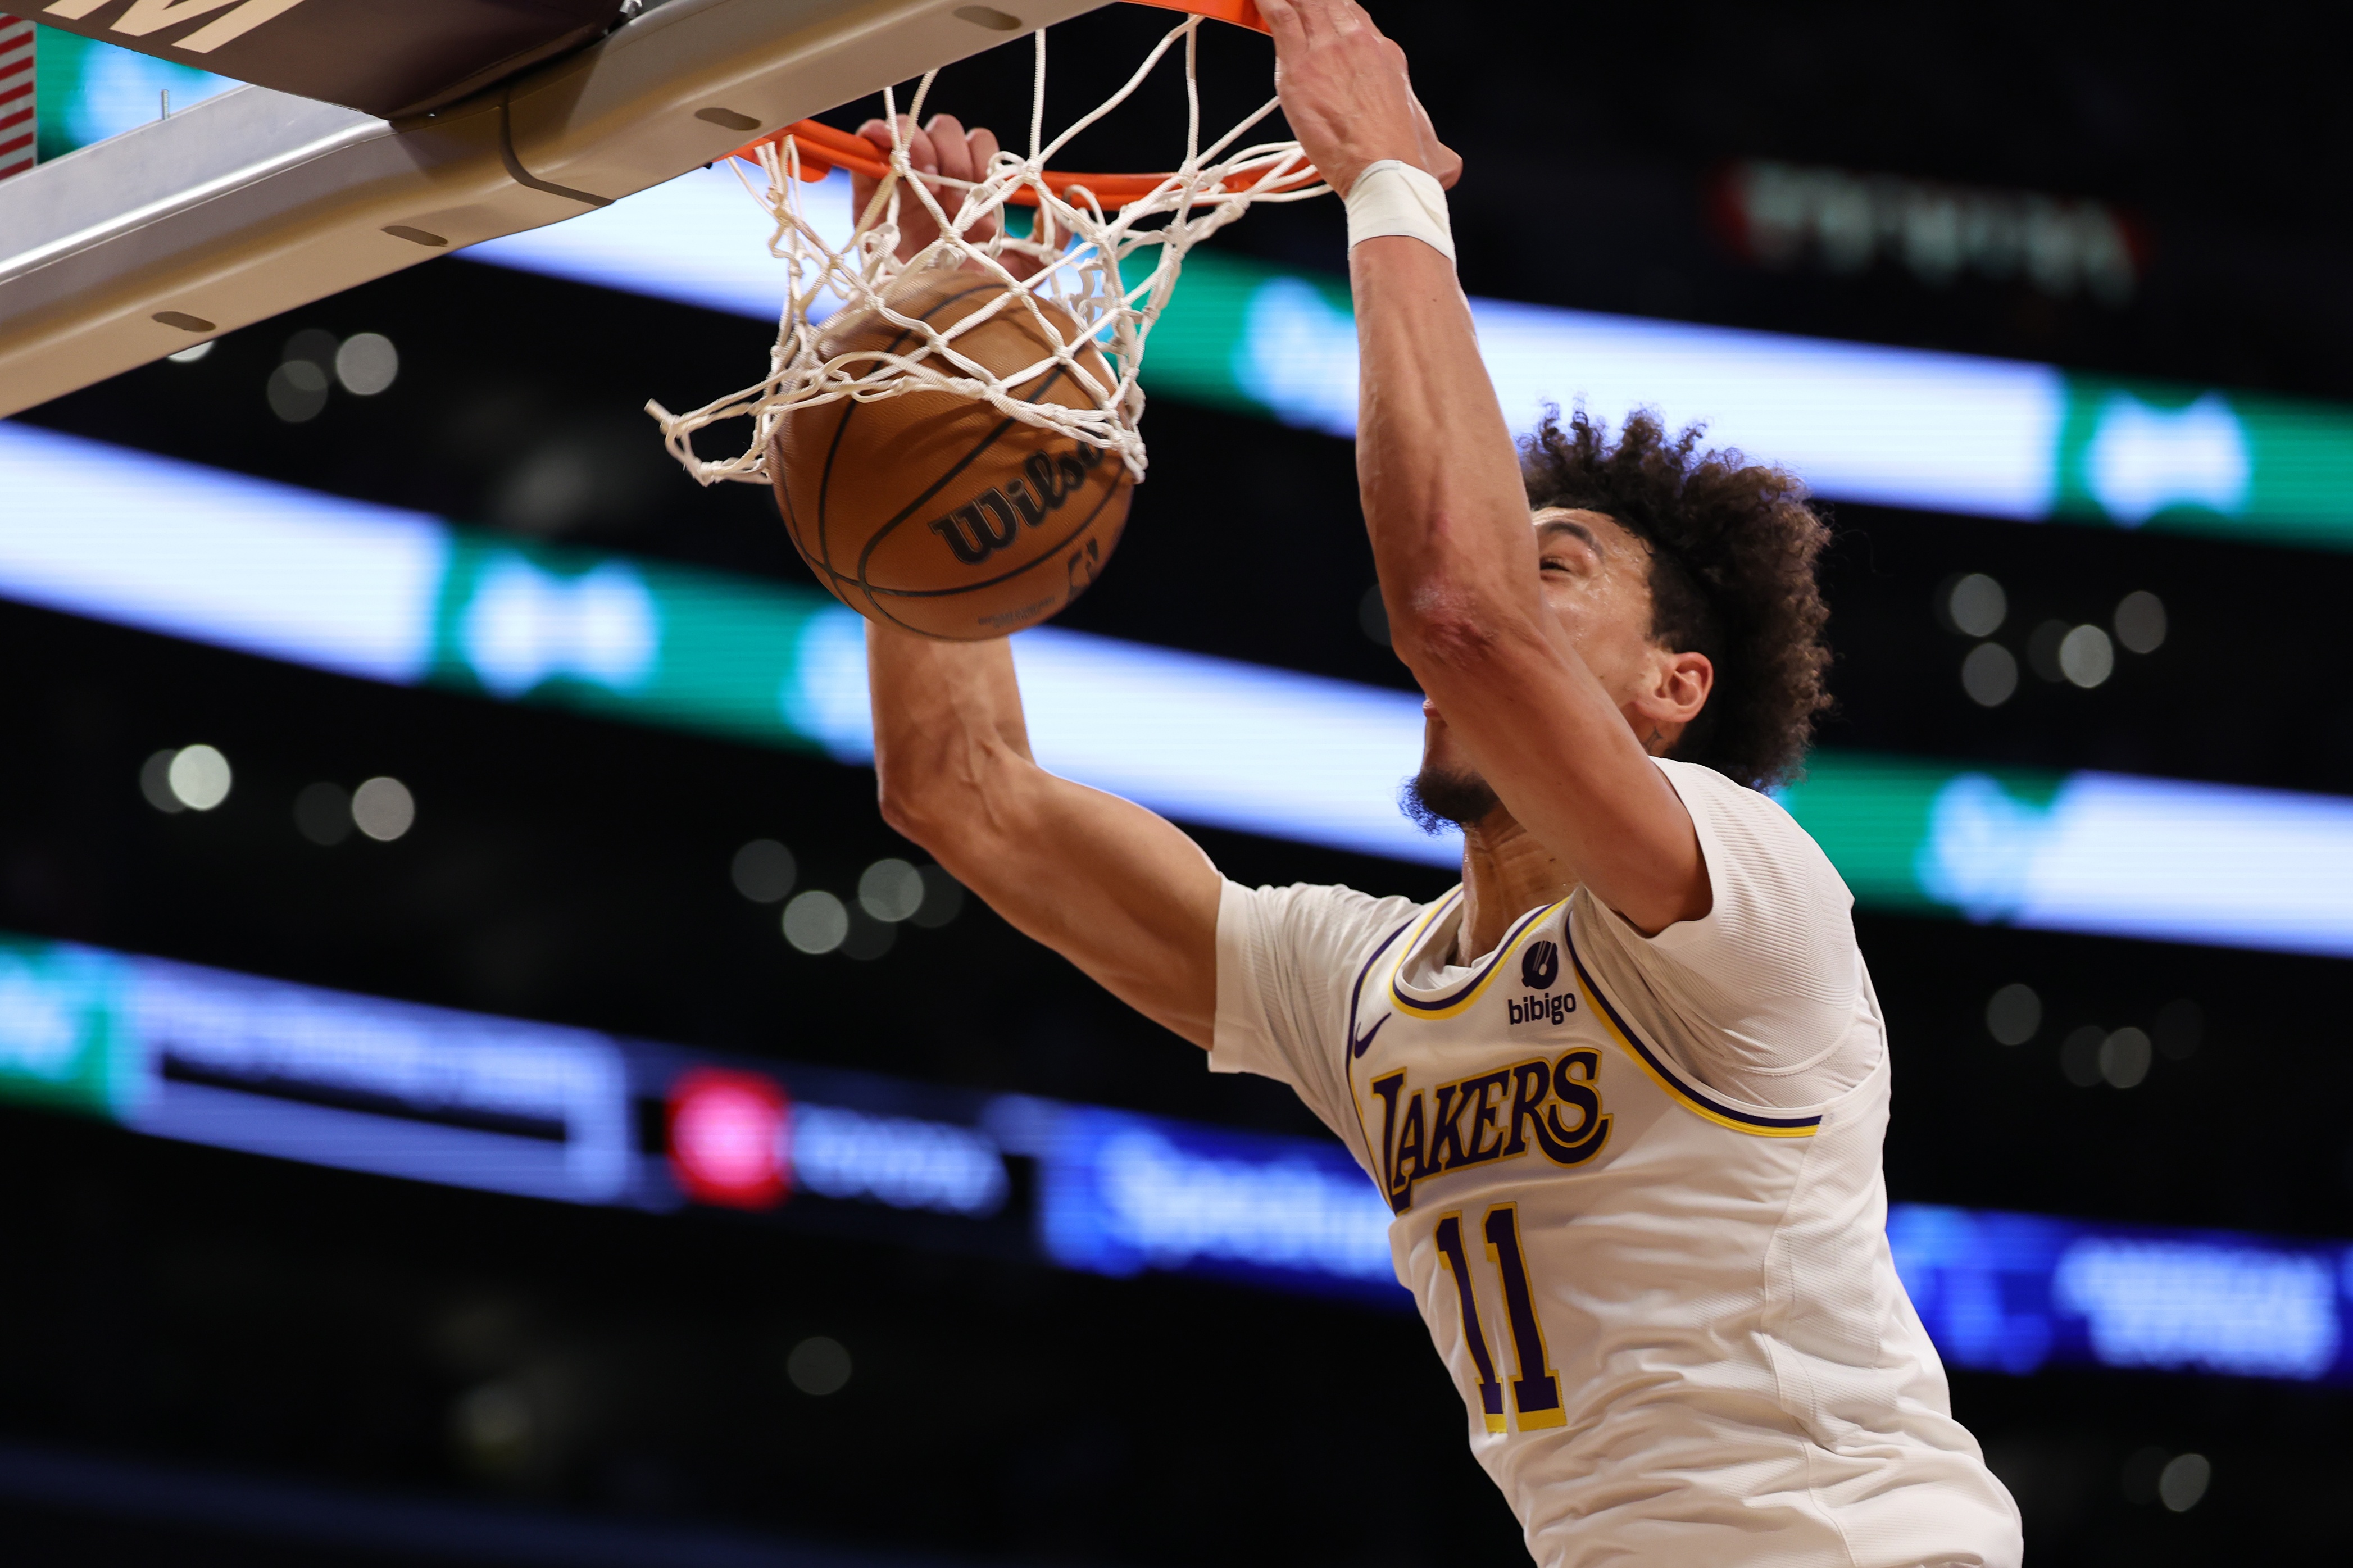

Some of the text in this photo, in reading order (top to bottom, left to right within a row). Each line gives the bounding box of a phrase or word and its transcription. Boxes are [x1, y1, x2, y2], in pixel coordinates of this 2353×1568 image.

[928, 440, 1105, 565] Wilso
[1508, 993, 1577, 1025] bibigo
[1370, 1047, 1614, 1218] LAKERS
[1433, 1201, 1568, 1433] 11
